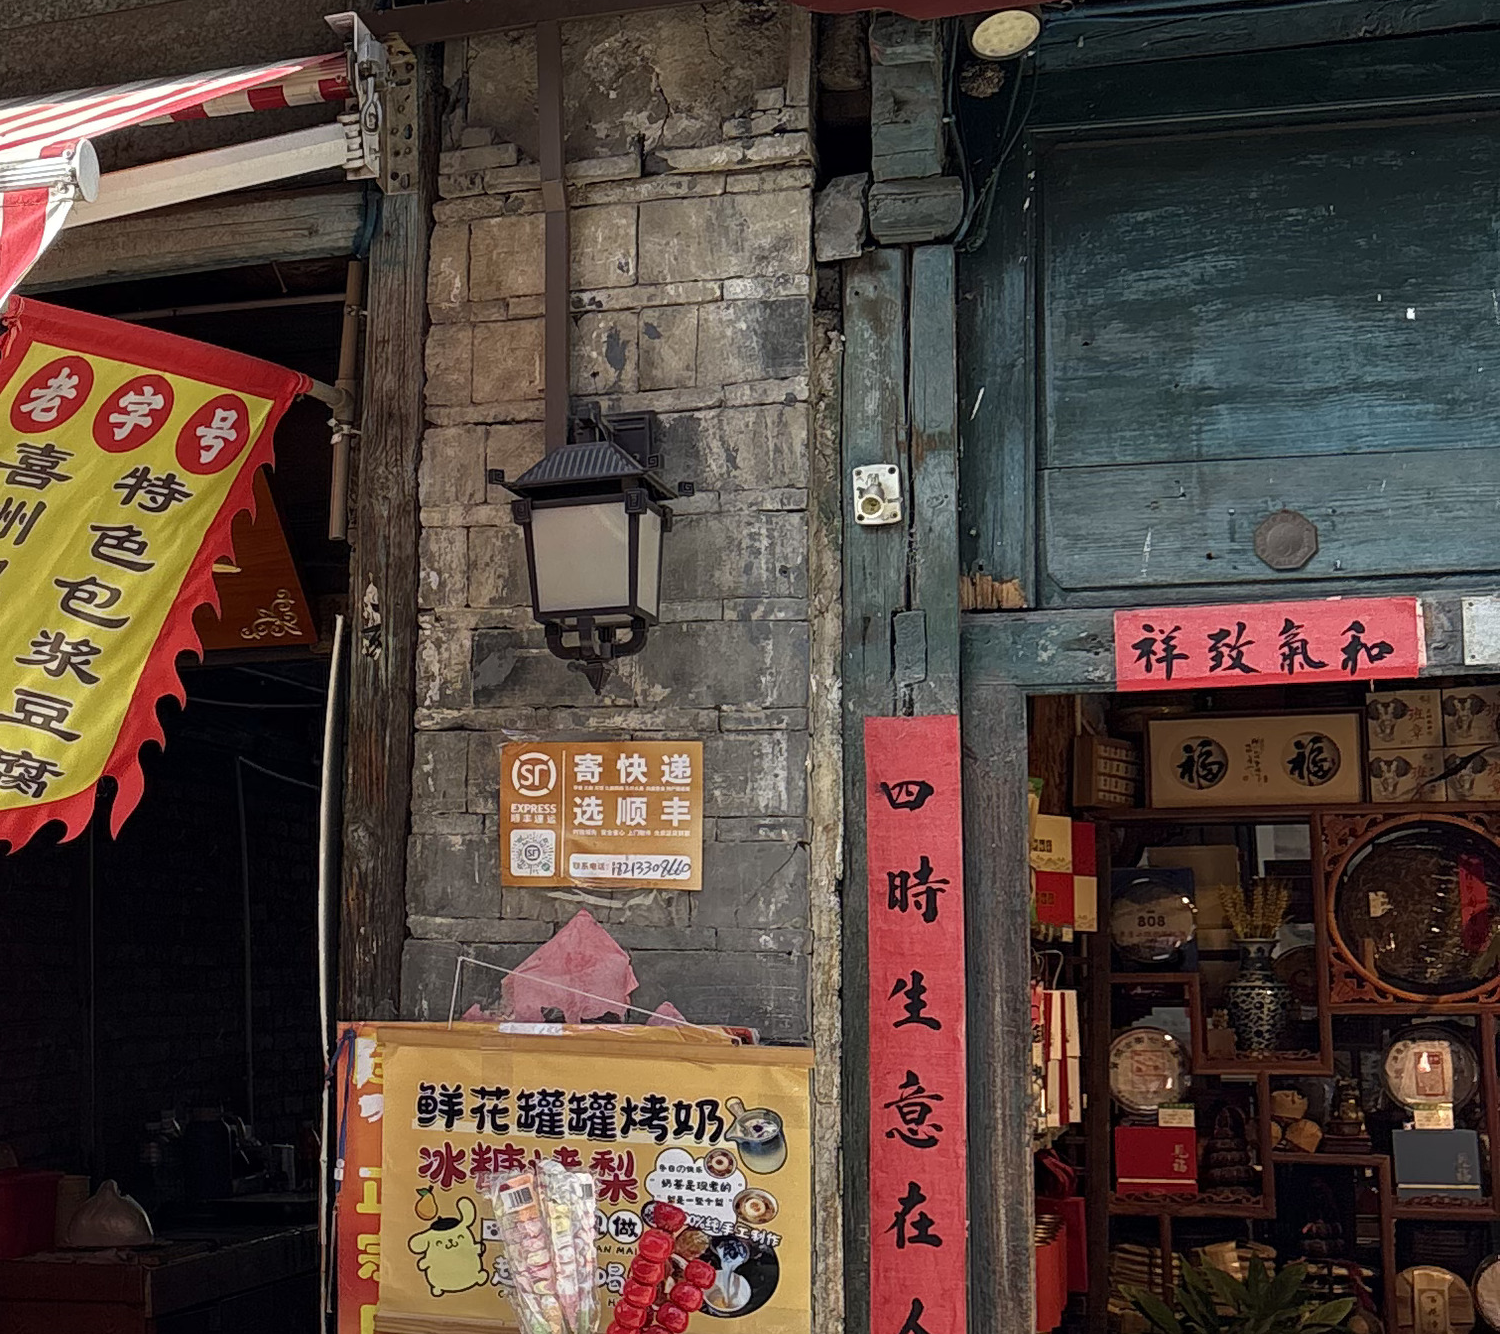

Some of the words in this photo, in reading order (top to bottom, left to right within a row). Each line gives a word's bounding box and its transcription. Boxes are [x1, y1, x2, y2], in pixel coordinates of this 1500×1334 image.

[19, 367, 238, 464] 老字号
[573, 752, 692, 785] 寄快递
[510, 802, 557, 815] EXPRESS
[572, 795, 692, 827] 选顺丰
[1137, 915, 1166, 928] 808
[415, 1081, 726, 1145] 鲜花罐罐烤奶
